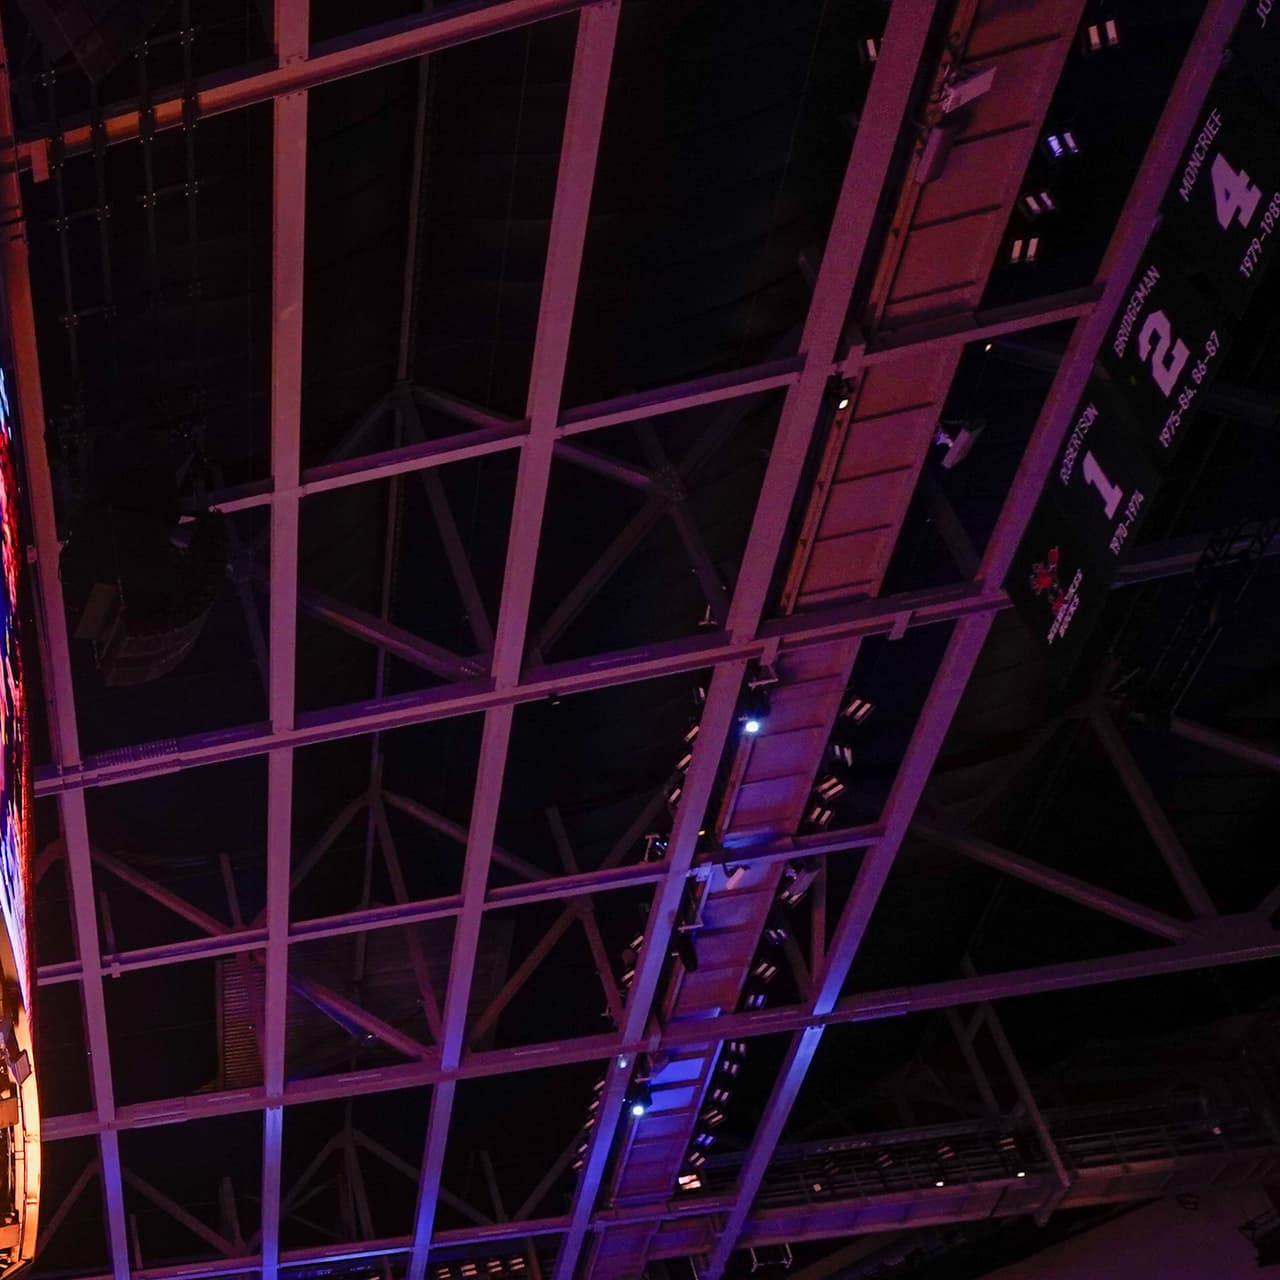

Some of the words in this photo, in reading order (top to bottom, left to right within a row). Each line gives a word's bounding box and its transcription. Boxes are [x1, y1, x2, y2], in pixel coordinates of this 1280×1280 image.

[1179, 107, 1222, 203] MONCRIEF
[1211, 152, 1263, 231] 4
[1113, 264, 1160, 359] BRIDGEMAN
[1139, 310, 1191, 398] 2
[1082, 450, 1124, 520] 1
